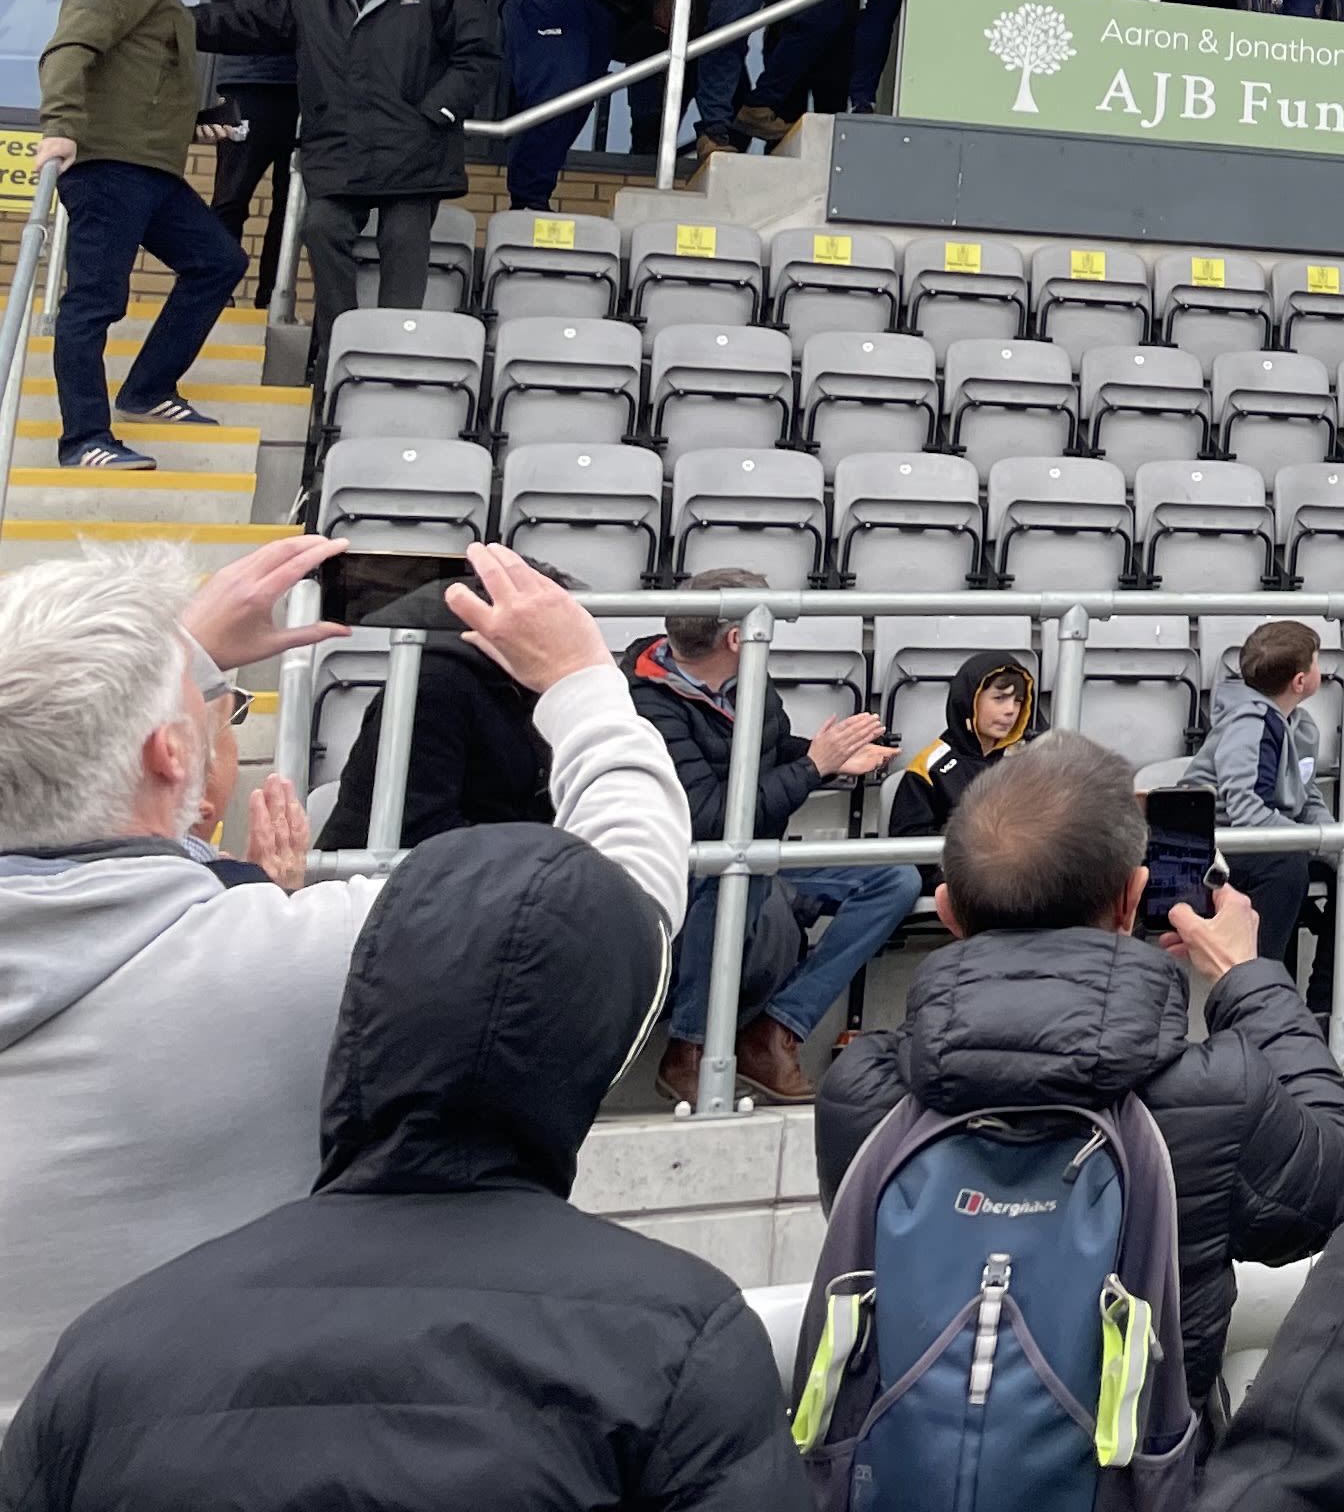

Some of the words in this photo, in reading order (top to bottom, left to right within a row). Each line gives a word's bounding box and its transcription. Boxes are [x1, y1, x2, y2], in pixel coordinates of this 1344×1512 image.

[1101, 18, 1189, 50] Aaron
[1198, 29, 1219, 54] &
[1095, 68, 1217, 129] AJB
